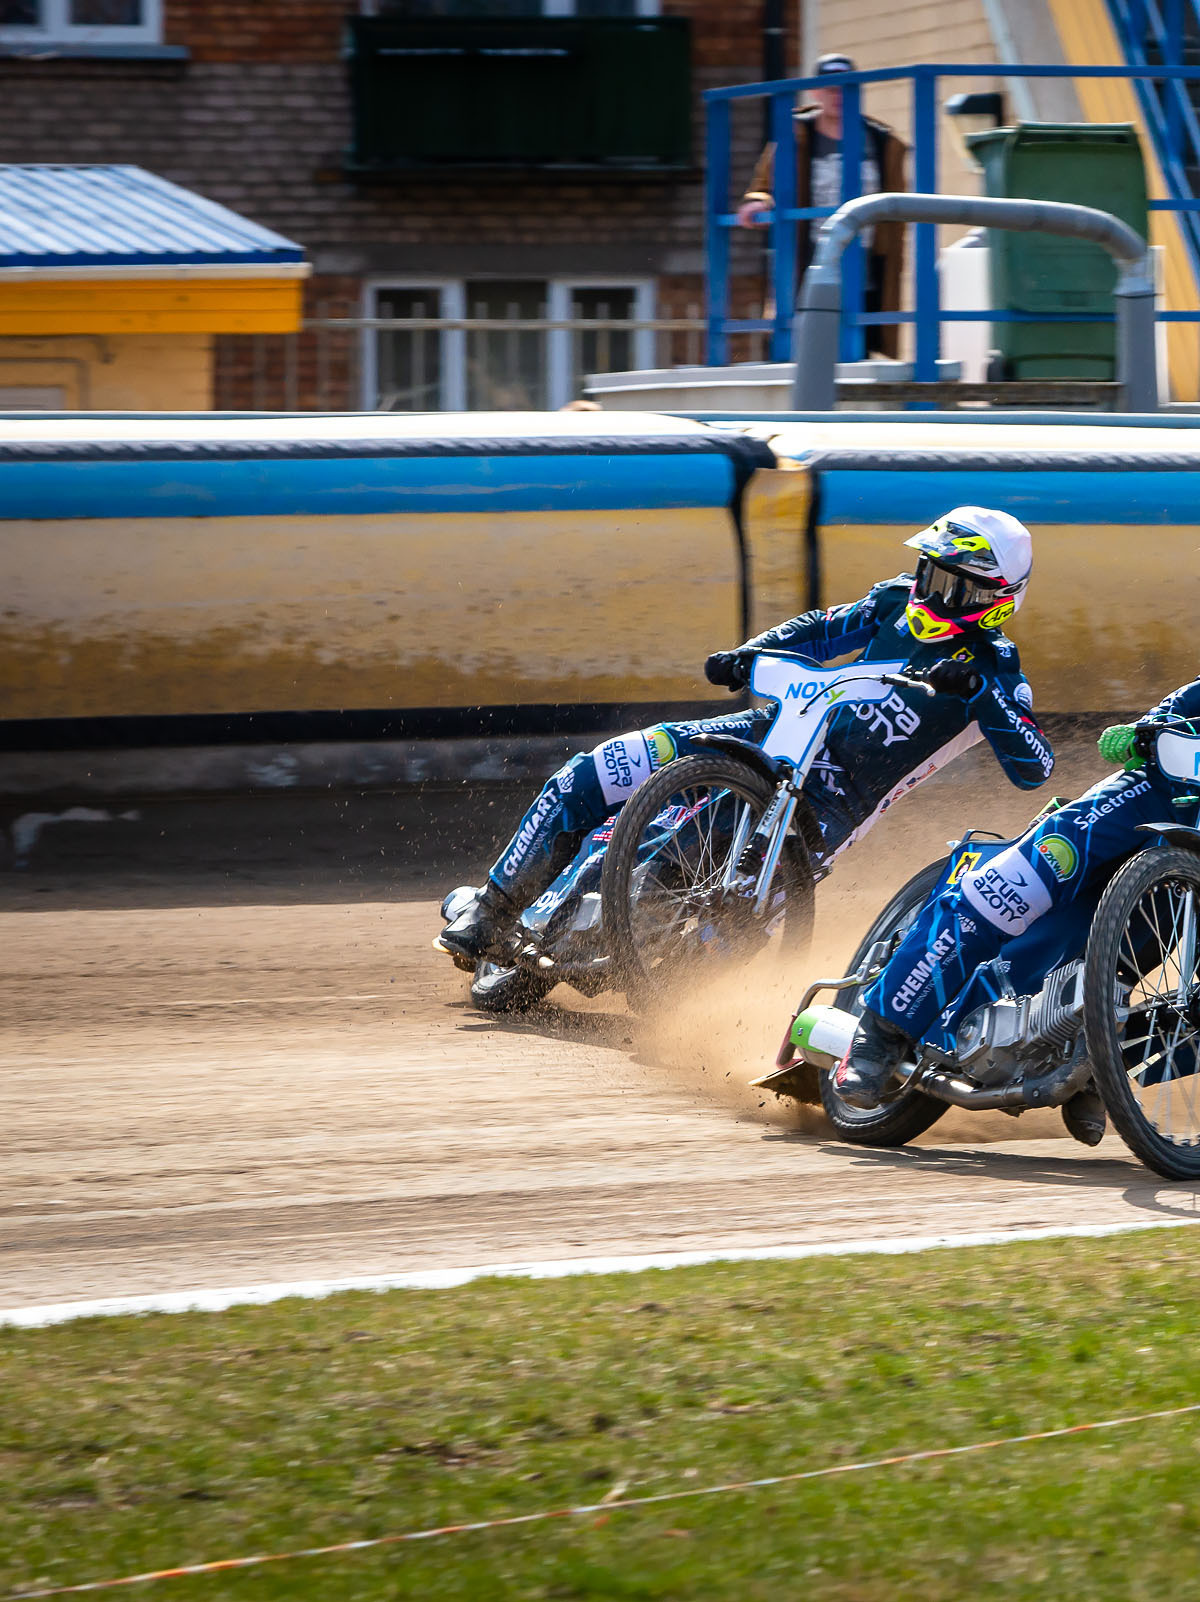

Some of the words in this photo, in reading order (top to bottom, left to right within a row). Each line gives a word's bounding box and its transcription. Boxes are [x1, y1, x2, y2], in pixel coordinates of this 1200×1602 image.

[676, 719, 753, 737] Saletrom
[991, 686, 1054, 778] Saetromag
[503, 787, 560, 877] CHEMART
[891, 927, 956, 1013] CHEMART
